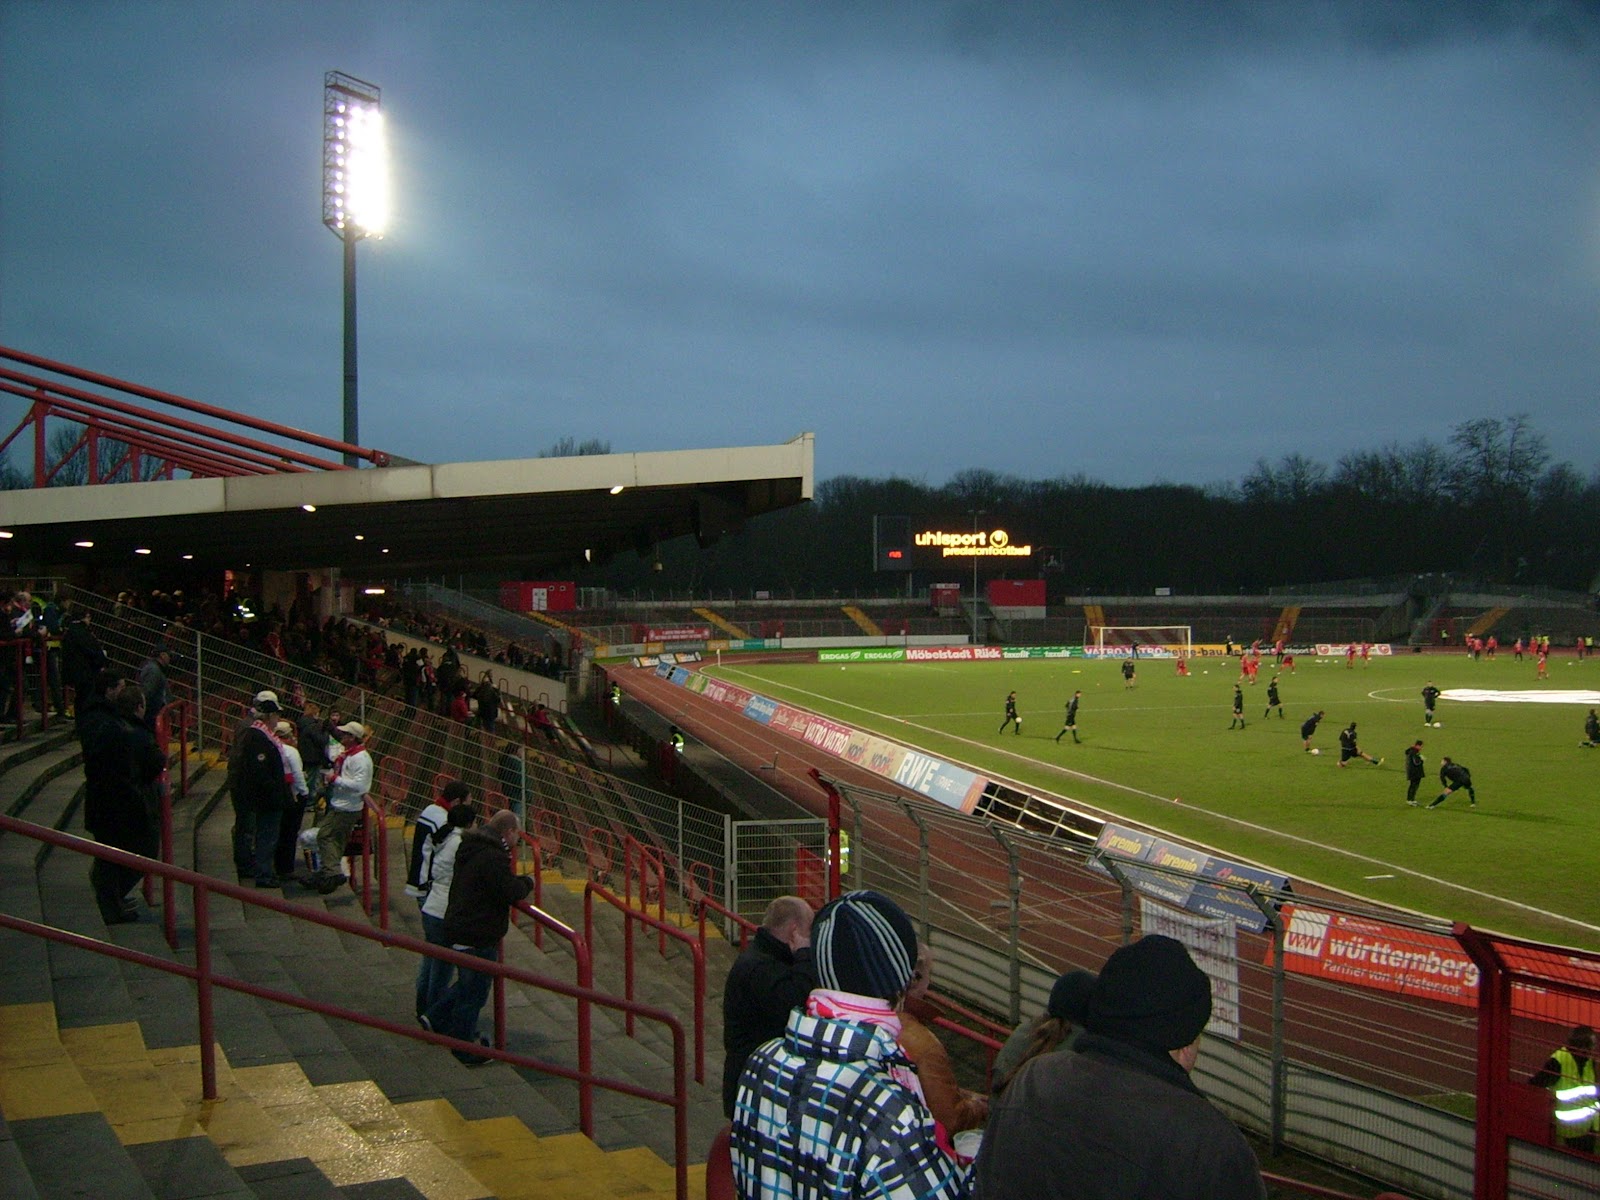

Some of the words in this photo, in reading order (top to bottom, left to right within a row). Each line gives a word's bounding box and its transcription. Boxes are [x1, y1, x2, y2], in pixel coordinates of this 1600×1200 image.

[915, 531, 986, 546] uhlsport
[906, 648, 972, 659] Möbelstadt
[895, 752, 940, 793] RWE
[1105, 835, 1142, 855] premio
[1160, 852, 1198, 873] premio
[1323, 959, 1366, 978] Partner
[1329, 936, 1480, 987] württemberg
